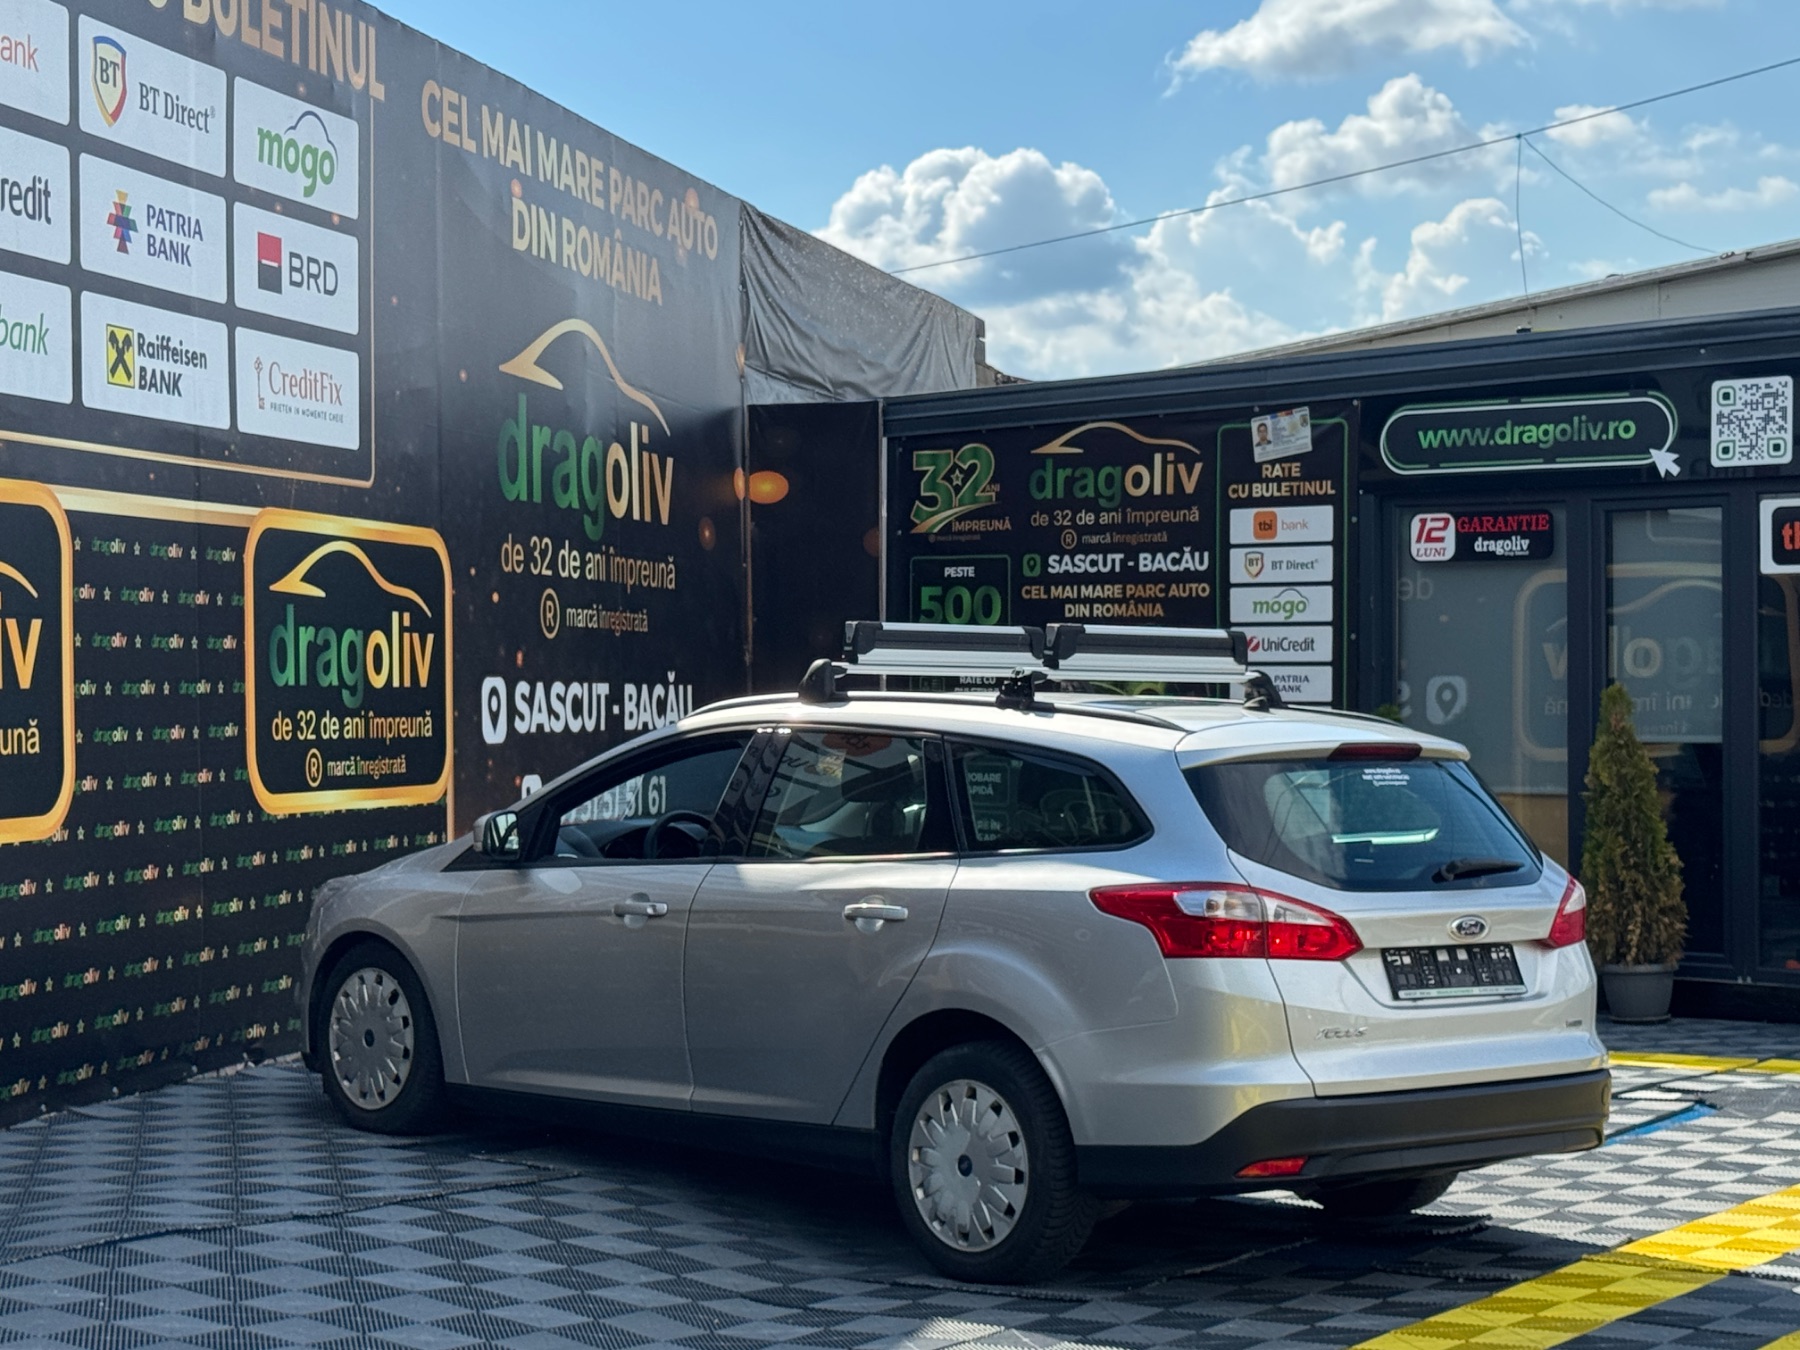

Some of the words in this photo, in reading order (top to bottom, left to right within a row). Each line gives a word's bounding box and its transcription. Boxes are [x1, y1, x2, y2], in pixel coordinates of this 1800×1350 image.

[1, 33, 39, 73] ank
[99, 56, 120, 88] BT
[138, 81, 160, 115] BT
[258, 127, 335, 198] mogo
[422, 79, 476, 153] CEL
[481, 105, 531, 176] MAI
[537, 131, 604, 210] MARE
[610, 167, 664, 237] PARC
[667, 198, 718, 260] AUTO
[0, 175, 52, 225] redit
[147, 203, 204, 242] PATRIA
[147, 234, 191, 267] BANK
[512, 197, 556, 263] DIN
[562, 217, 662, 305] ROMÂNIA
[289, 251, 338, 296] BRD
[137, 333, 207, 369] Raiffeisen
[138, 367, 182, 397] BANK
[269, 361, 342, 406] CreditFix
[1418, 415, 1637, 449] www.dragoliv.ro
[499, 393, 673, 540] dragoliv
[1029, 453, 1203, 508] dragoliv
[1262, 463, 1301, 478] RATE
[910, 443, 995, 524] 32
[985, 484, 1000, 493] ANI
[1228, 484, 1249, 498] CU
[1252, 480, 1336, 497] BULETINUL
[952, 516, 1011, 532] ÎMPREUNĂ
[1031, 511, 1048, 526] de
[1053, 510, 1072, 526] 32
[1076, 509, 1095, 525] de
[1099, 509, 1121, 524] ani
[1126, 506, 1199, 526] împreună
[1258, 519, 1273, 531] tbi
[1281, 519, 1309, 531] bank
[1416, 517, 1450, 543] 12
[1457, 513, 1550, 533] GARANTIE
[92, 538, 127, 555] dragoliv
[150, 543, 184, 560] dragoliv
[206, 547, 237, 564] dragoliv
[1082, 532, 1111, 544] marcă
[1112, 532, 1168, 545] înregistrată
[1416, 547, 1447, 557] LUNI
[1474, 535, 1530, 555] dragoliv
[501, 533, 524, 573] de
[530, 536, 552, 575] 32
[558, 540, 580, 578] de
[585, 546, 605, 581] ani
[610, 547, 675, 593] împreună
[944, 566, 975, 578] PESTE
[1048, 554, 1124, 573] SASCUT
[1139, 547, 1209, 572] BACĂU
[1248, 558, 1260, 567] BT
[1271, 560, 1284, 570] BT
[121, 587, 155, 605] dragoliv
[178, 590, 211, 607] dragoliv
[919, 585, 1001, 624] 500
[1022, 586, 1047, 599] CEL
[1051, 585, 1077, 598] MAI
[1081, 584, 1123, 598] MARE
[1126, 584, 1165, 597] PARC
[1168, 583, 1210, 597] AUTO
[566, 604, 598, 628] marcă
[600, 606, 648, 636] înregistrată
[1065, 604, 1089, 617] DIN
[1093, 600, 1164, 617] ROMÂNIA
[1253, 600, 1307, 620] mogo
[92, 632, 128, 650] dragoliv
[151, 634, 185, 651] dragoliv
[207, 635, 238, 652] dragoliv
[269, 604, 434, 708] dragoliv
[1261, 637, 1315, 652] UniCredit
[121, 679, 156, 697] dragoliv
[180, 679, 212, 697] dragoliv
[1274, 675, 1310, 683] PATRIA
[514, 681, 609, 733] SASCUT
[624, 671, 693, 730] BACĂU
[94, 725, 129, 745] dragoliv
[152, 724, 186, 742] dragoliv
[208, 722, 239, 740] dragoliv
[272, 713, 292, 741] de
[297, 711, 316, 740] 32
[321, 711, 339, 738] de
[344, 711, 364, 738] ani
[369, 710, 432, 745] împreună
[123, 772, 158, 791] dragoliv
[181, 768, 214, 786] dragoliv
[327, 756, 355, 776] marcă
[357, 755, 406, 779] înregistrată
[648, 775, 666, 815] 61
[95, 820, 131, 840] dragoliv
[154, 815, 188, 834] dragoliv
[210, 810, 241, 828] dragoliv
[64, 871, 101, 891] dragoliv
[125, 864, 160, 884] dragoliv
[182, 858, 215, 876] dragoliv
[236, 851, 267, 869] dragoliv
[286, 845, 314, 863] dragoliv
[33, 923, 72, 944] dragoliv
[96, 914, 132, 935] dragoliv
[156, 906, 190, 925] dragoliv
[212, 898, 244, 916] dragoliv
[264, 890, 292, 908] dragoliv
[64, 968, 101, 988] dragoliv
[125, 957, 160, 977] dragoliv
[183, 947, 216, 966] dragoliv
[238, 937, 268, 955] dragoliv
[32, 1022, 70, 1043] dragoliv
[95, 1009, 130, 1029] dragoliv
[154, 997, 187, 1016] dragoliv
[210, 985, 241, 1003] dragoliv
[263, 975, 293, 993] dragoliv
